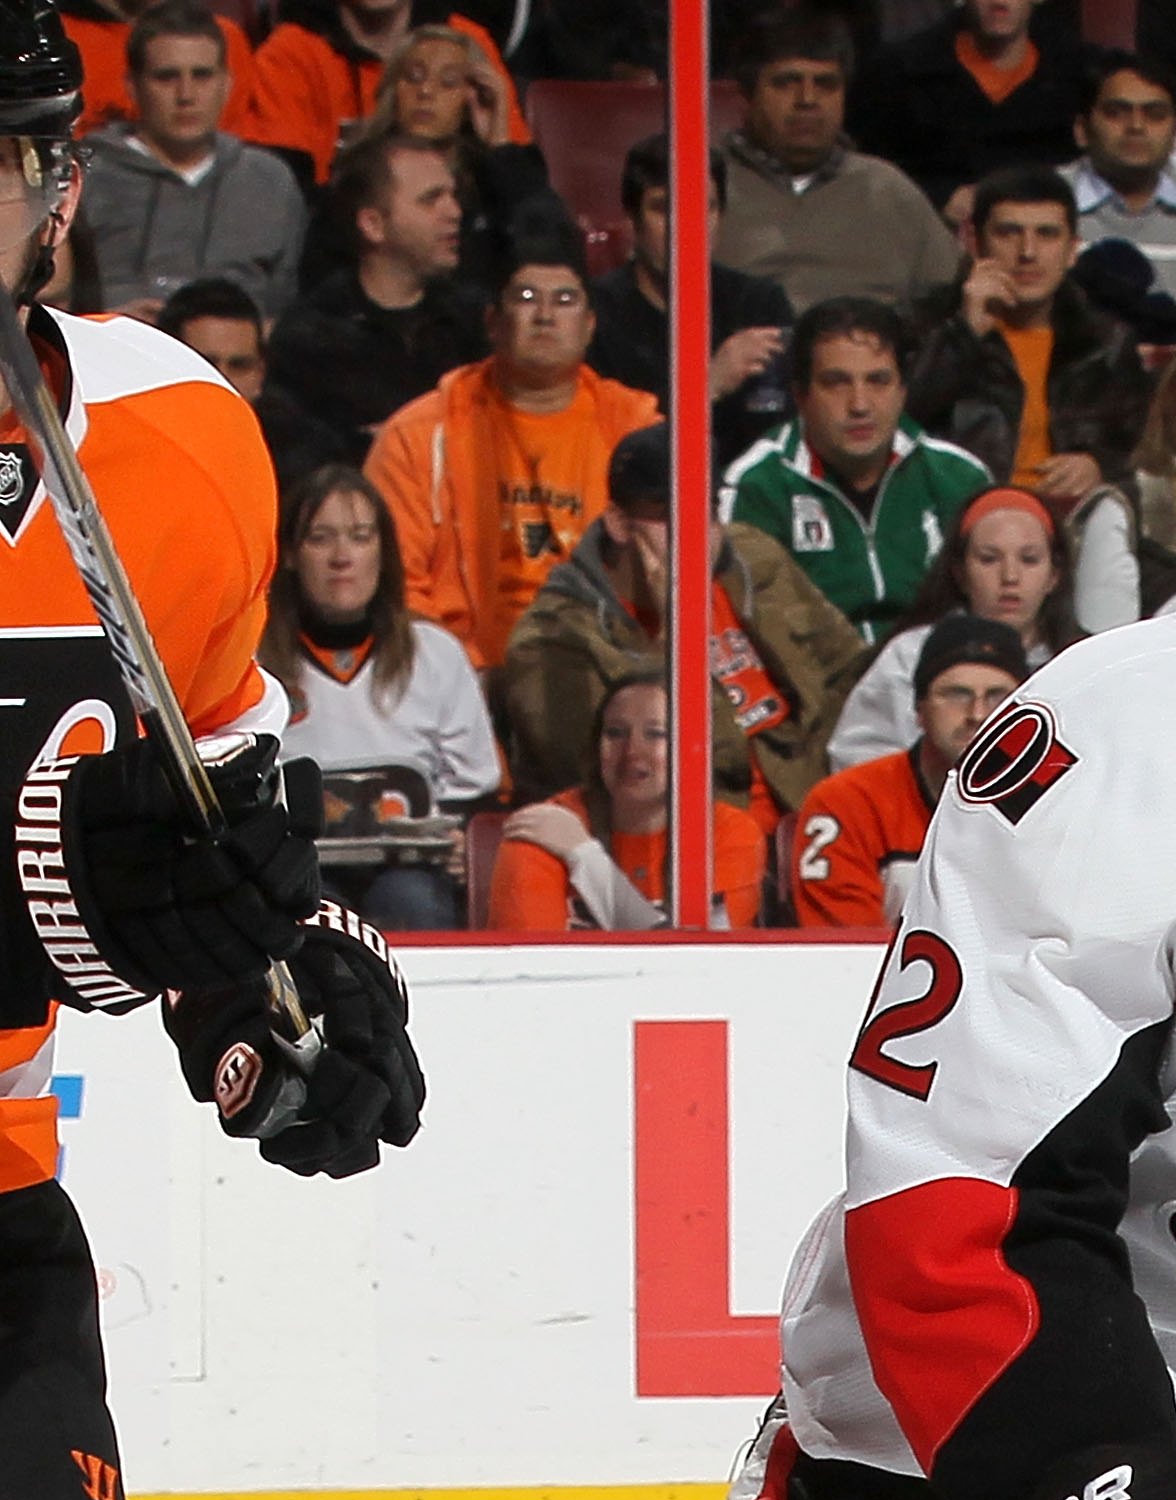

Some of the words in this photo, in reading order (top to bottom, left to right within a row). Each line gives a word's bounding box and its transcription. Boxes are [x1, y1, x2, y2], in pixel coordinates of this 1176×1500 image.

[15, 756, 147, 1008] WARRIOR
[800, 814, 839, 880] 2
[849, 916, 963, 1103] 2
